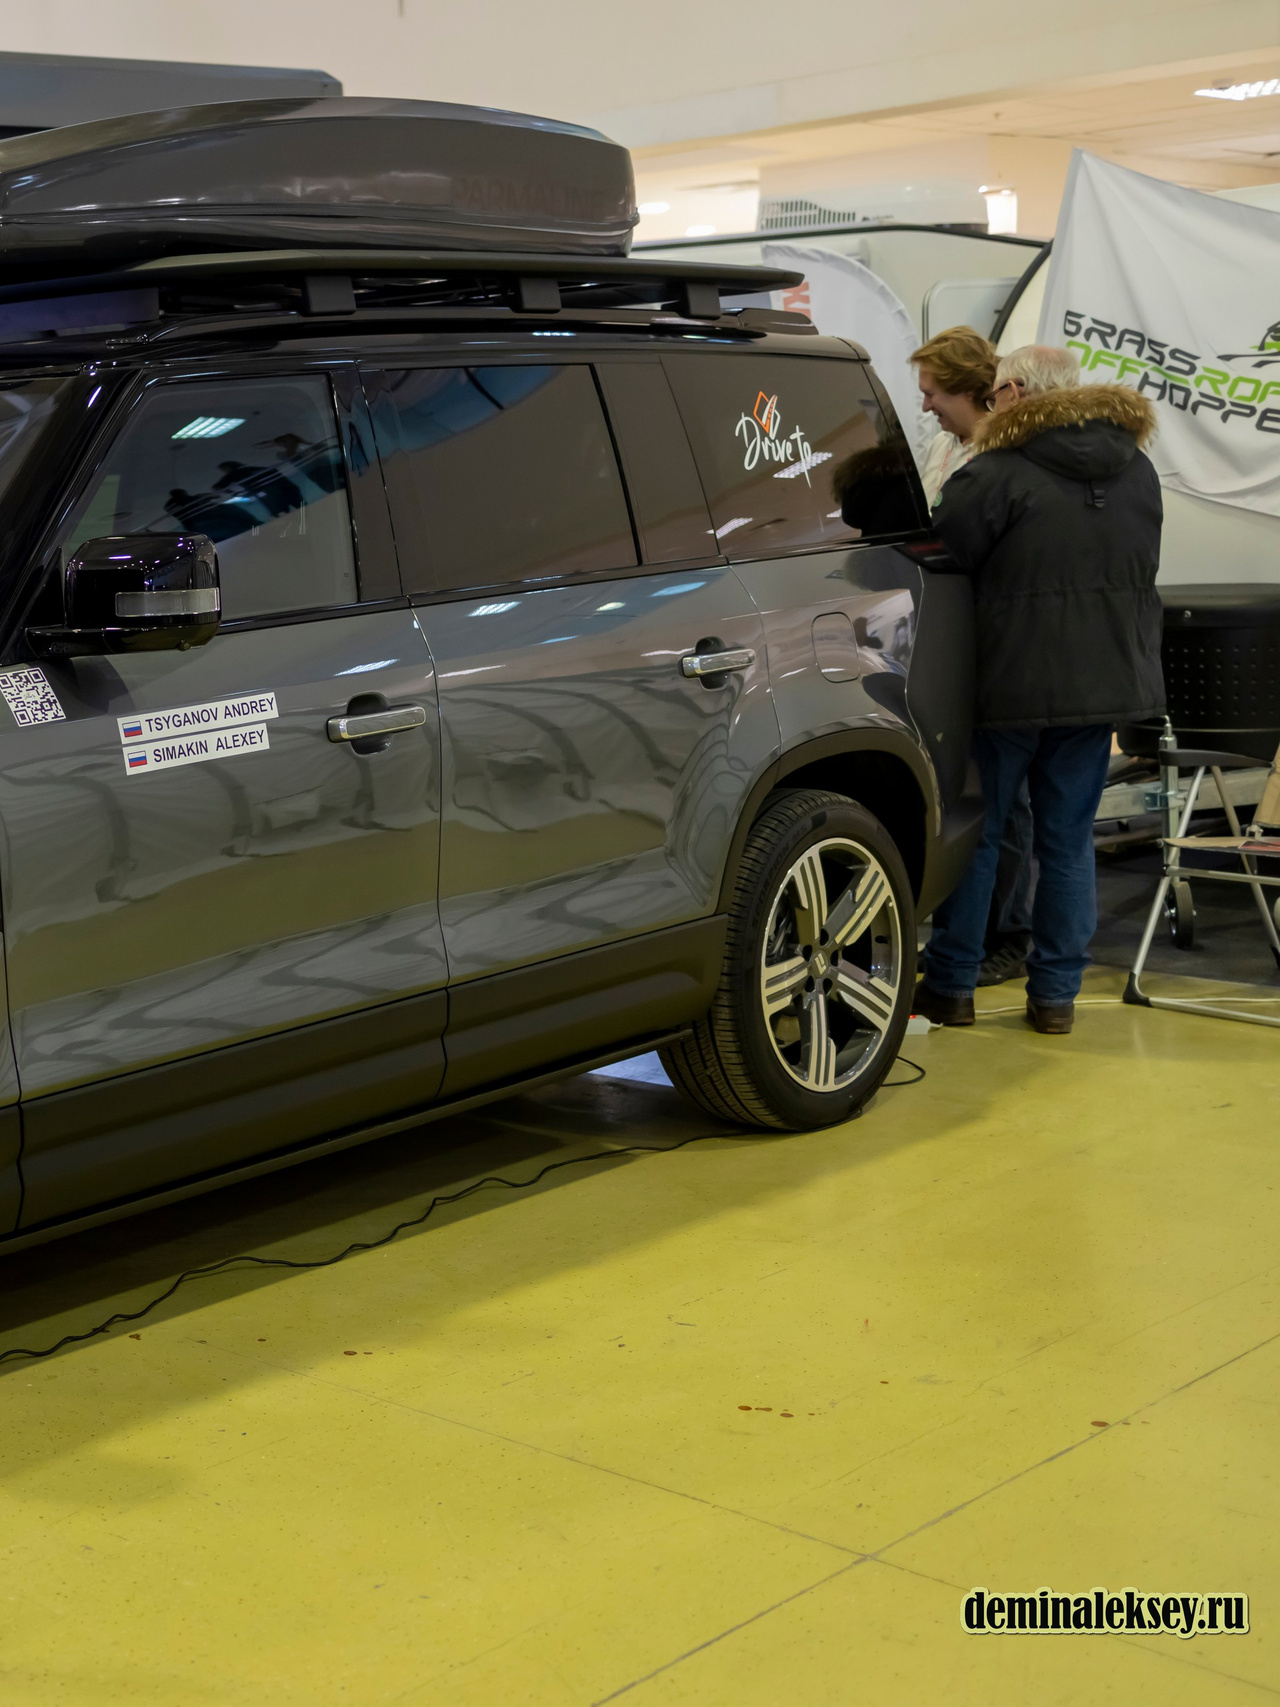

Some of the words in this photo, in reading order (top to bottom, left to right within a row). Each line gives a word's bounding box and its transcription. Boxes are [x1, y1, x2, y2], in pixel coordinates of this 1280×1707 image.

[1063, 309, 1201, 376] GRASS
[735, 411, 794, 470] Drive
[144, 707, 219, 732] TSYGANOV
[223, 697, 274, 719] ANDREY
[153, 739, 209, 763] SIMAKIN
[215, 729, 265, 751] ALEXEY
